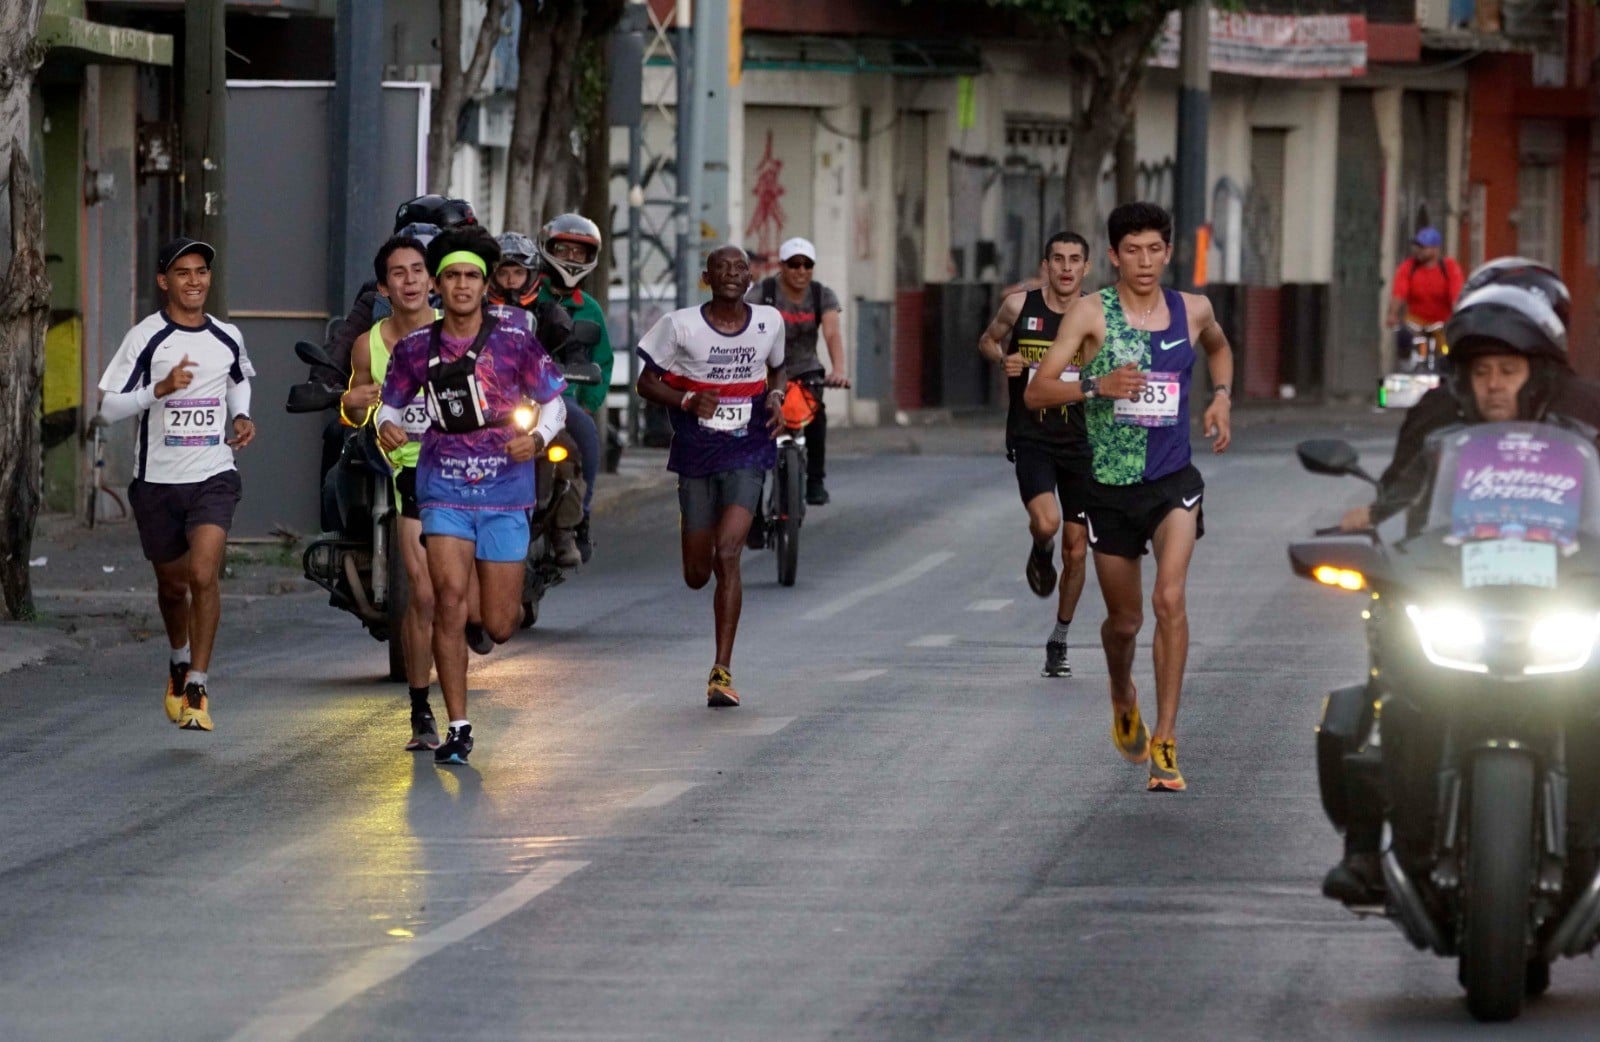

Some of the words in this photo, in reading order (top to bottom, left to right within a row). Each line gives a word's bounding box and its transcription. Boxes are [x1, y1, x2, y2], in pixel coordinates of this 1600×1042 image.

[709, 345, 755, 354] Marathon
[735, 365, 752, 374] 10K
[170, 410, 215, 426] 2705
[401, 407, 426, 423] 63
[715, 407, 742, 421] 431
